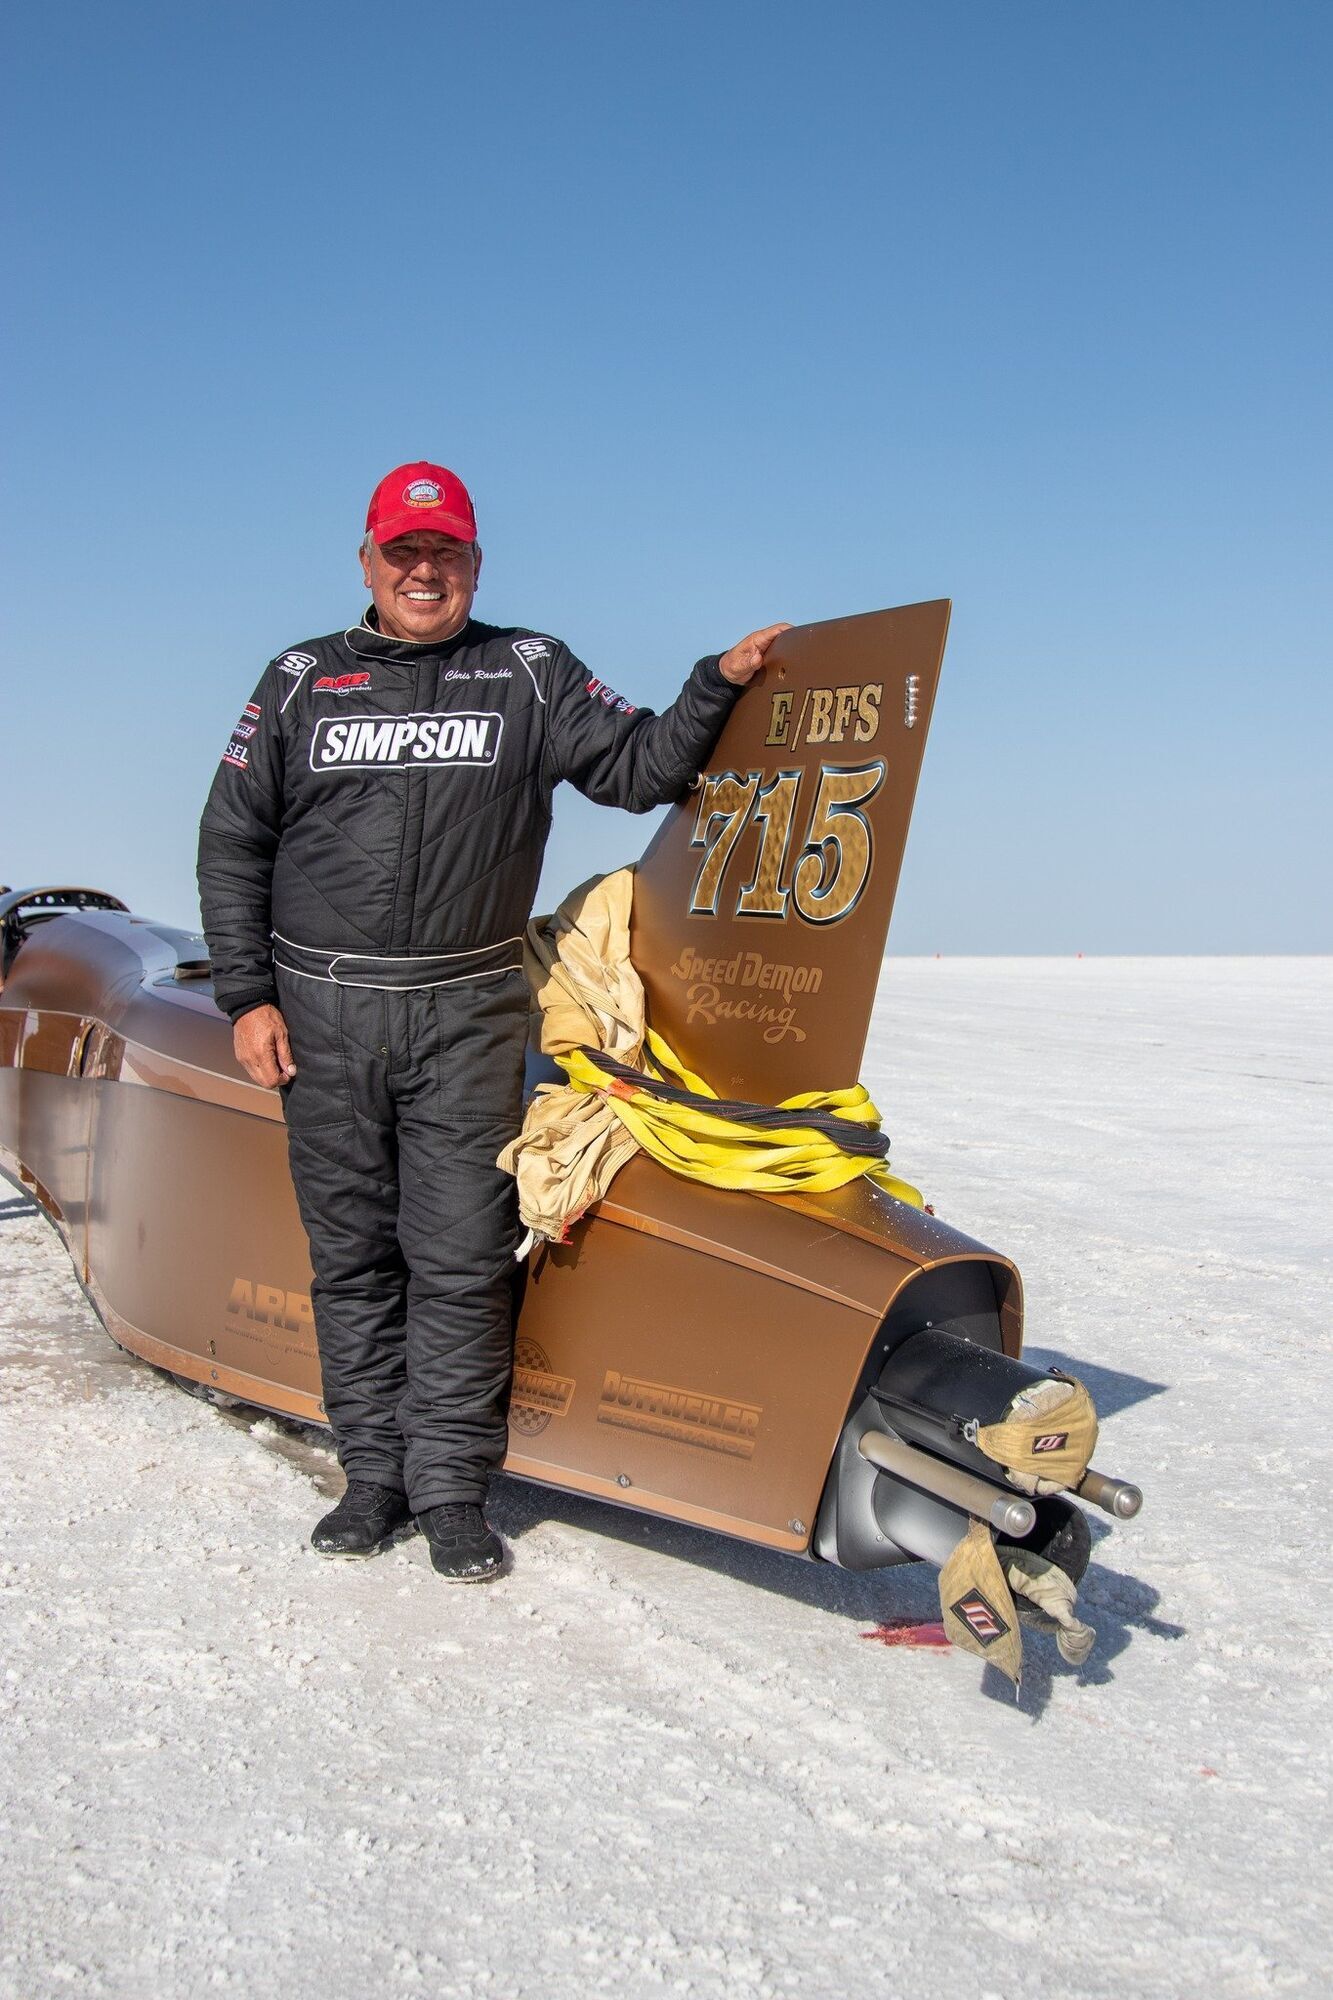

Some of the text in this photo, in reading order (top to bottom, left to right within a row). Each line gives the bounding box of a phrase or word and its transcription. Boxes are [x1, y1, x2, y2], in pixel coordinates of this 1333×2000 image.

[312, 672, 371, 690] ARP
[444, 668, 513, 681] Chris Raschke
[321, 719, 490, 763] SIMPSON
[765, 683, 884, 752] E/BFS
[689, 759, 886, 927] 715
[686, 982, 807, 1044] Racing
[601, 1370, 760, 1437] DUTTWEILER
